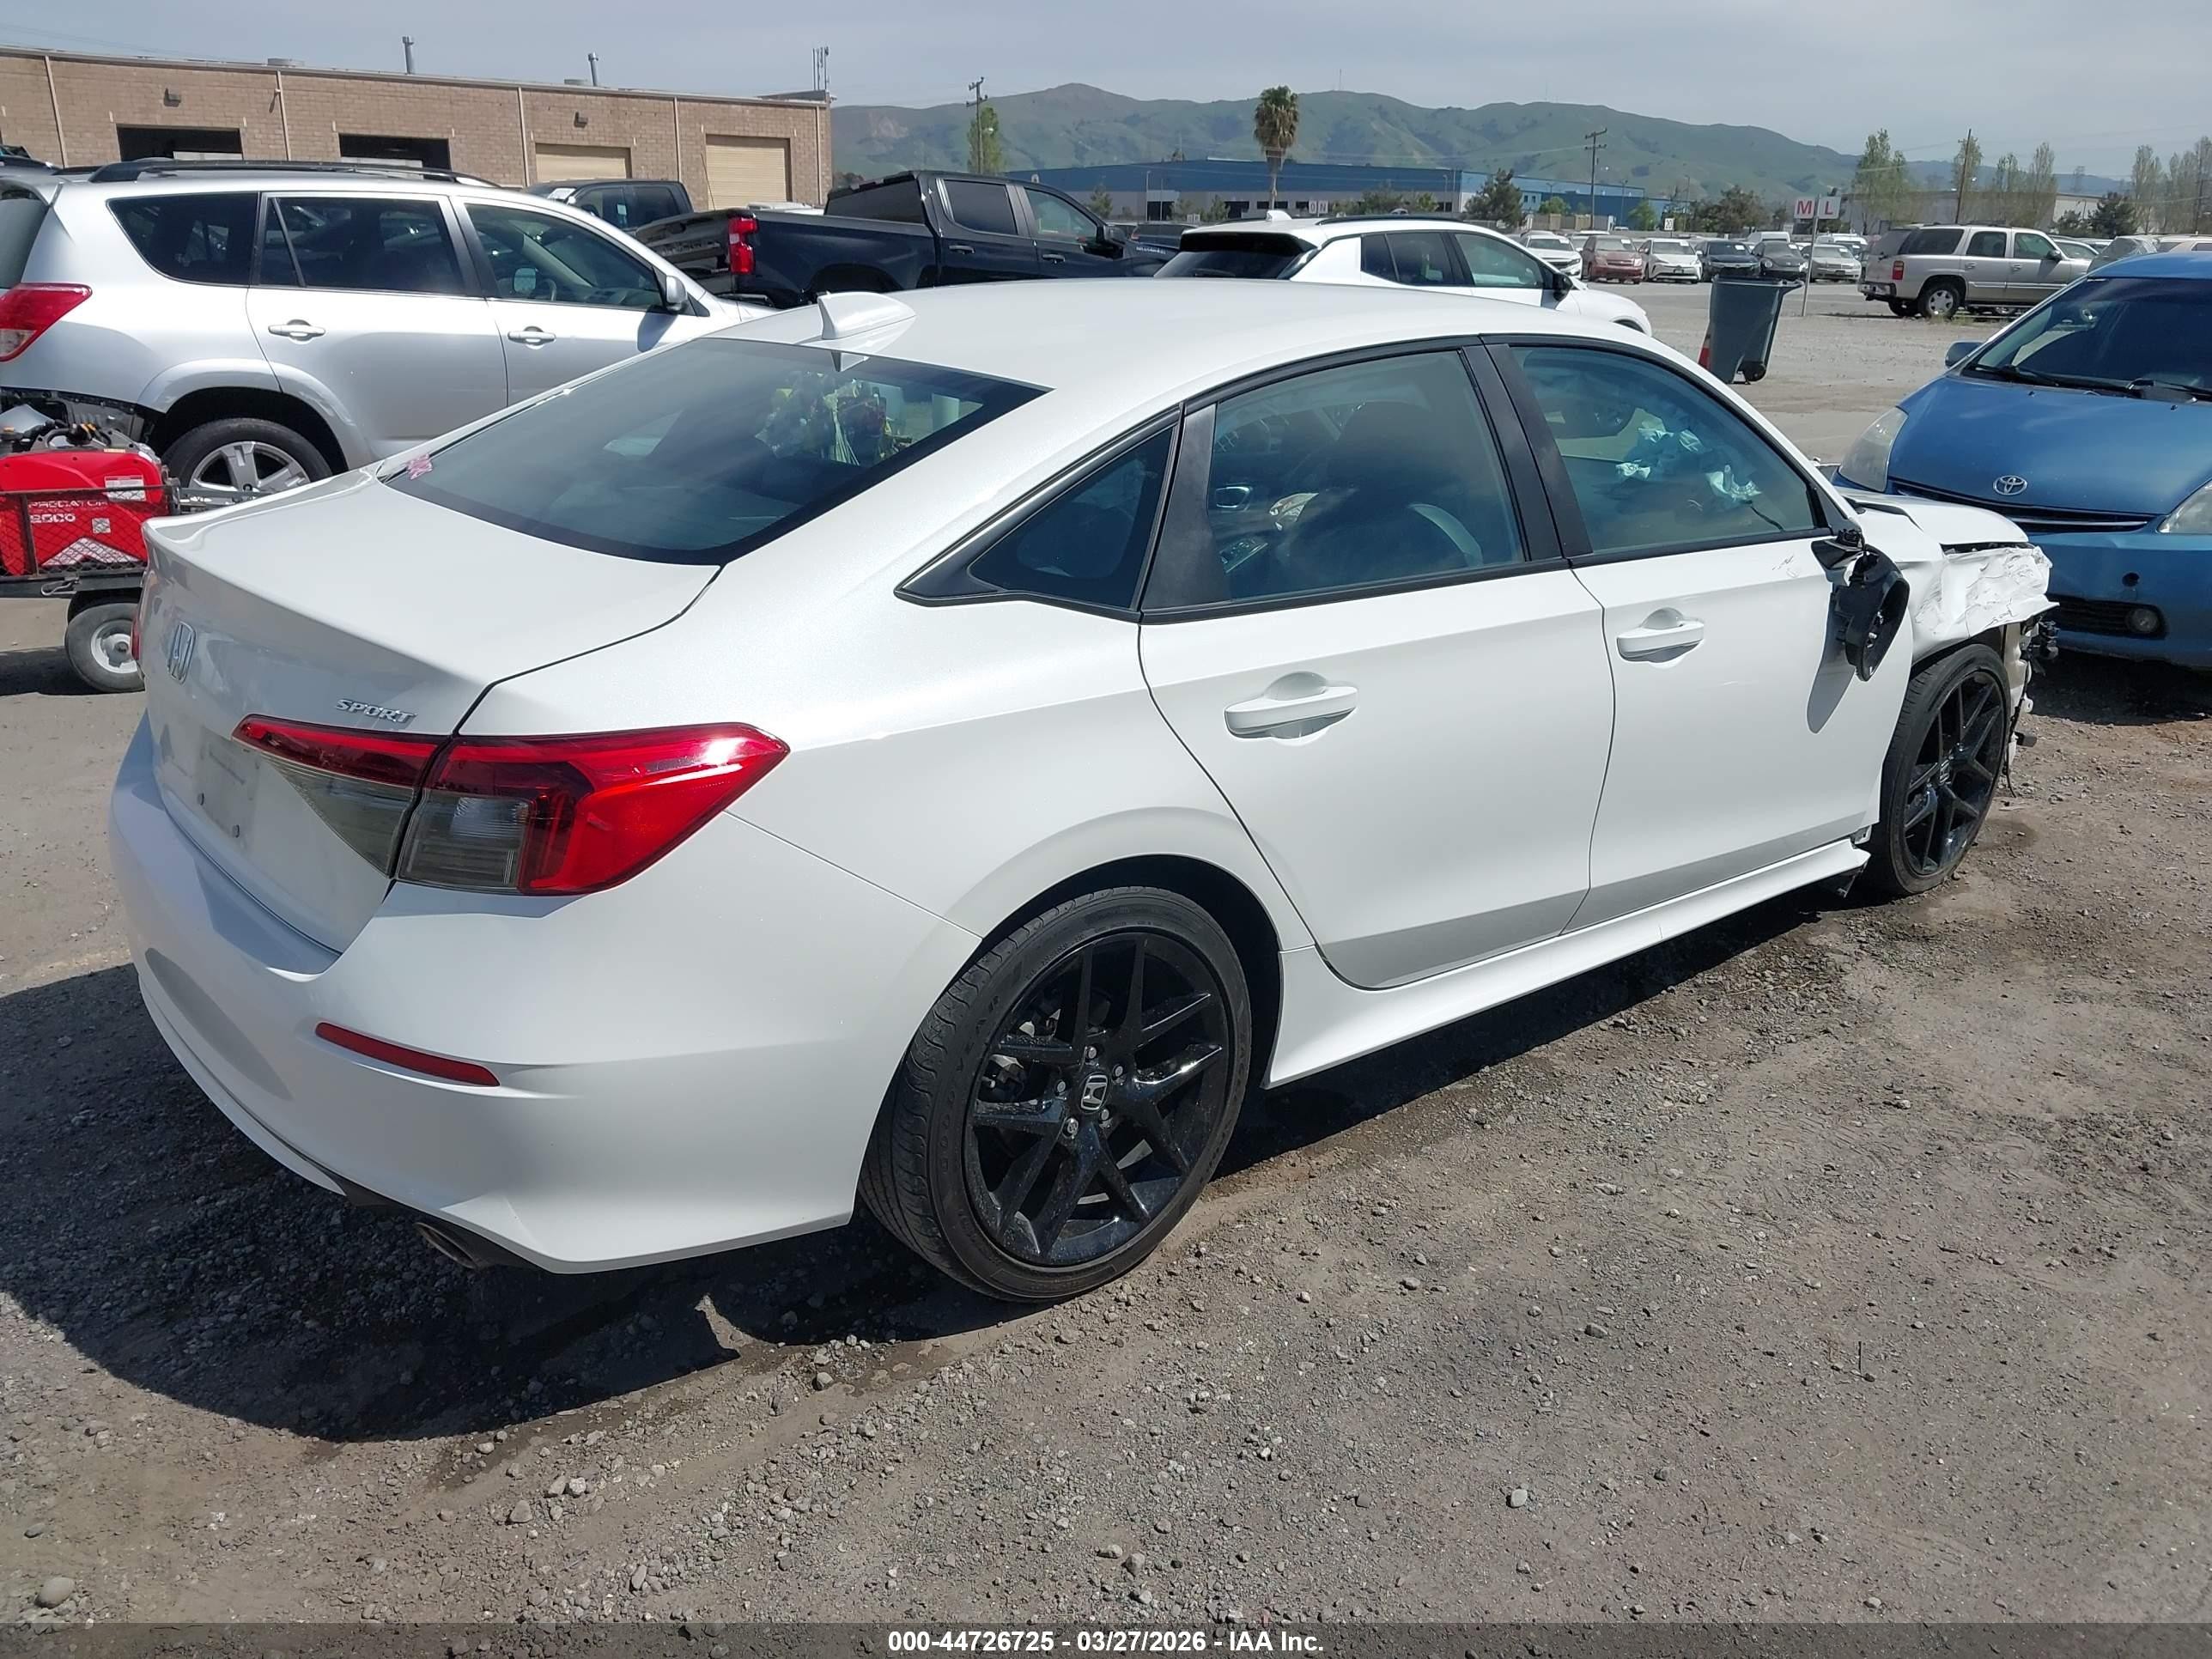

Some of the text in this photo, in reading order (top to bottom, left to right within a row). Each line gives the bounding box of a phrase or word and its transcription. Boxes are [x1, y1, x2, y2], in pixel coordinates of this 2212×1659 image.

[1797, 200, 1812, 215] M
[1825, 200, 1833, 215] L
[336, 698, 418, 722] SPORT
